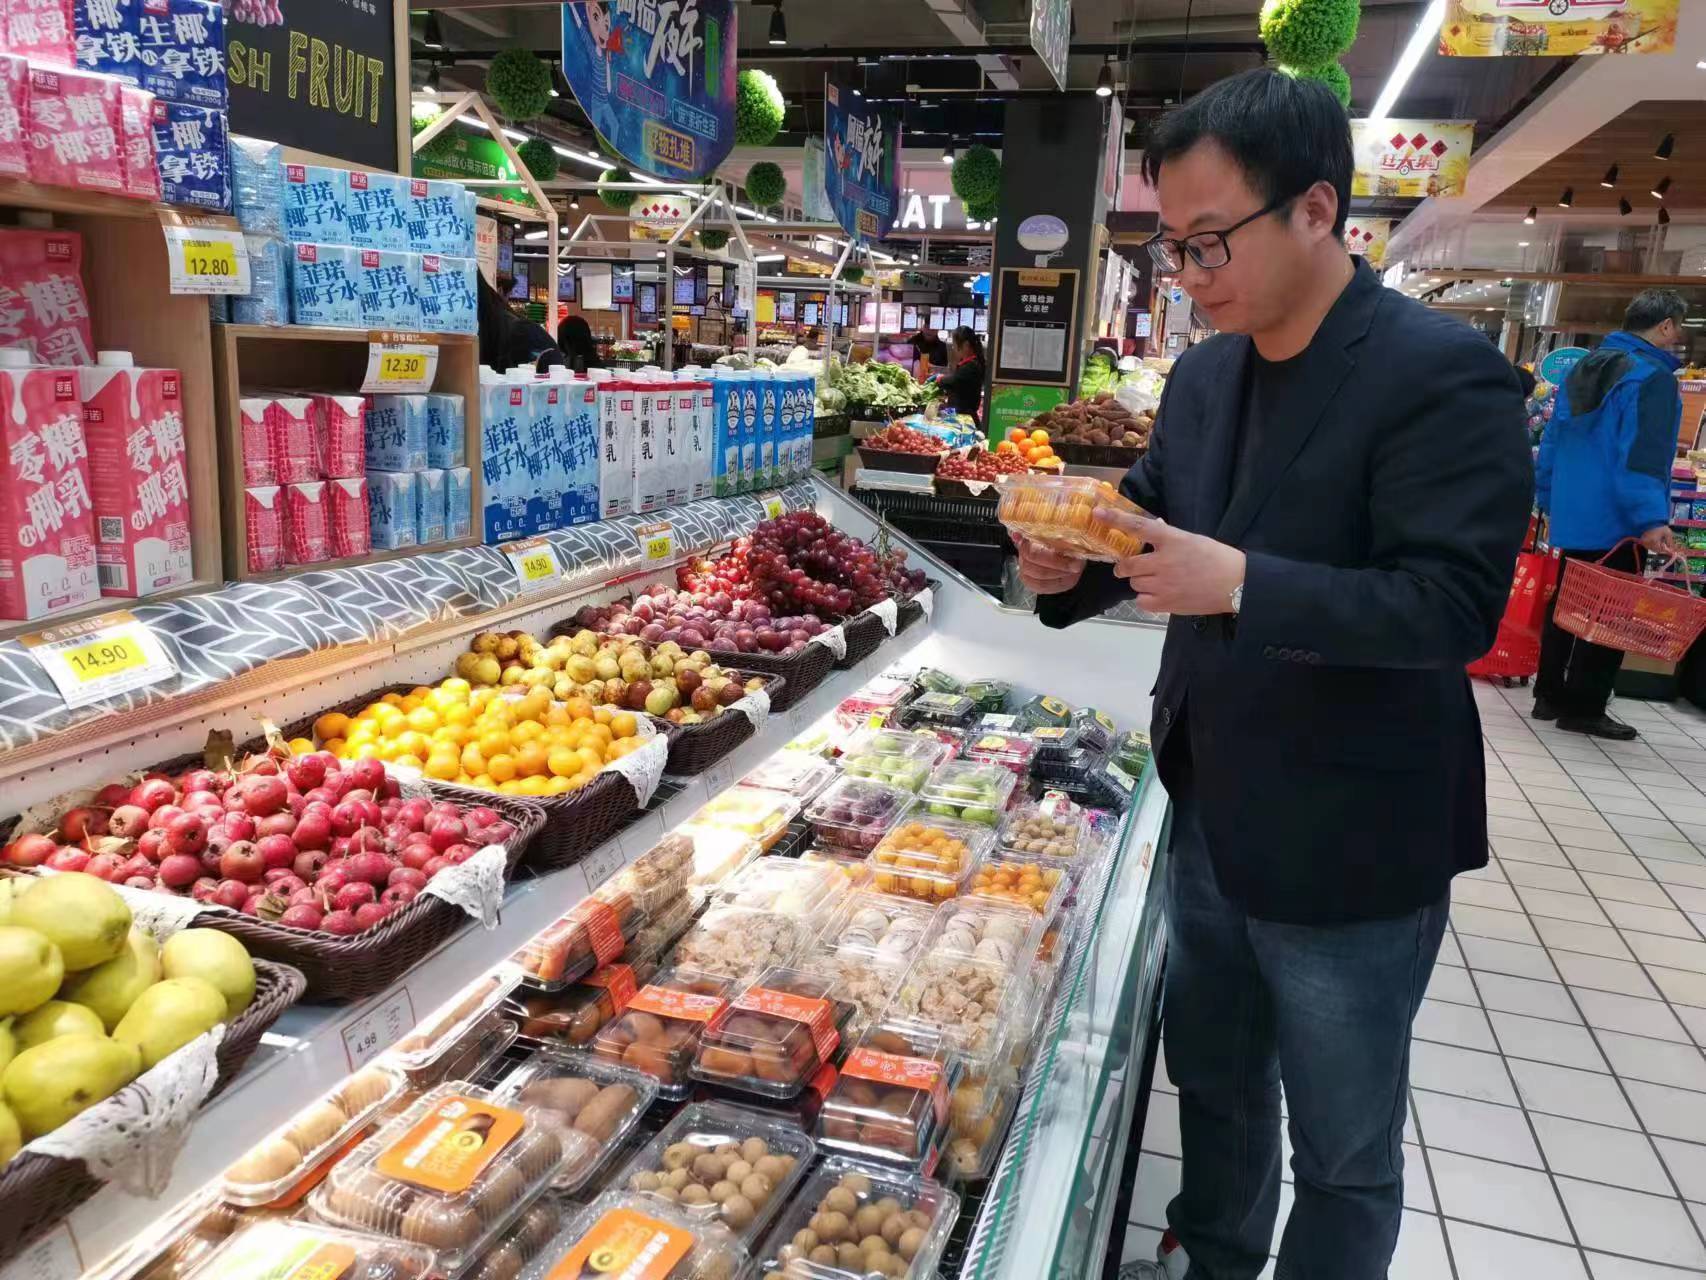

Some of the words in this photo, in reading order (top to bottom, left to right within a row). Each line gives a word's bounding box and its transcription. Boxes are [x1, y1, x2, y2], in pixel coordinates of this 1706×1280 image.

[140, 13, 208, 46] 生椰
[228, 40, 271, 92] SH
[289, 30, 384, 124] FRUIT
[160, 152, 223, 183] 拿铁
[291, 181, 334, 206] 菲诺
[352, 188, 395, 213] 菲诺
[411, 196, 454, 219] 菲诺
[286, 200, 346, 228] 椰子水
[347, 207, 407, 235] 椰子水
[408, 215, 465, 241] 椰子水
[191, 259, 229, 276] 12.80
[303, 260, 346, 284] 菲诺
[363, 265, 407, 289] 菲诺
[296, 280, 359, 309] 椰子水
[424, 271, 466, 294] 菲诺
[359, 285, 418, 313] 椰子水
[419, 289, 476, 316] 椰子水
[386, 357, 418, 372] 12.30
[127, 411, 185, 473] 零糖
[485, 417, 519, 453] 菲诺
[529, 415, 554, 449] 菲诺
[564, 413, 593, 446] 菲诺
[10, 415, 87, 483] 零糖
[528, 439, 564, 480] 椰子水
[562, 436, 599, 474] 椰子水
[482, 442, 529, 486] 椰子水
[525, 558, 547, 572] 14.90
[72, 645, 128, 671] 14.90
[357, 1032, 377, 1053] 4.98
